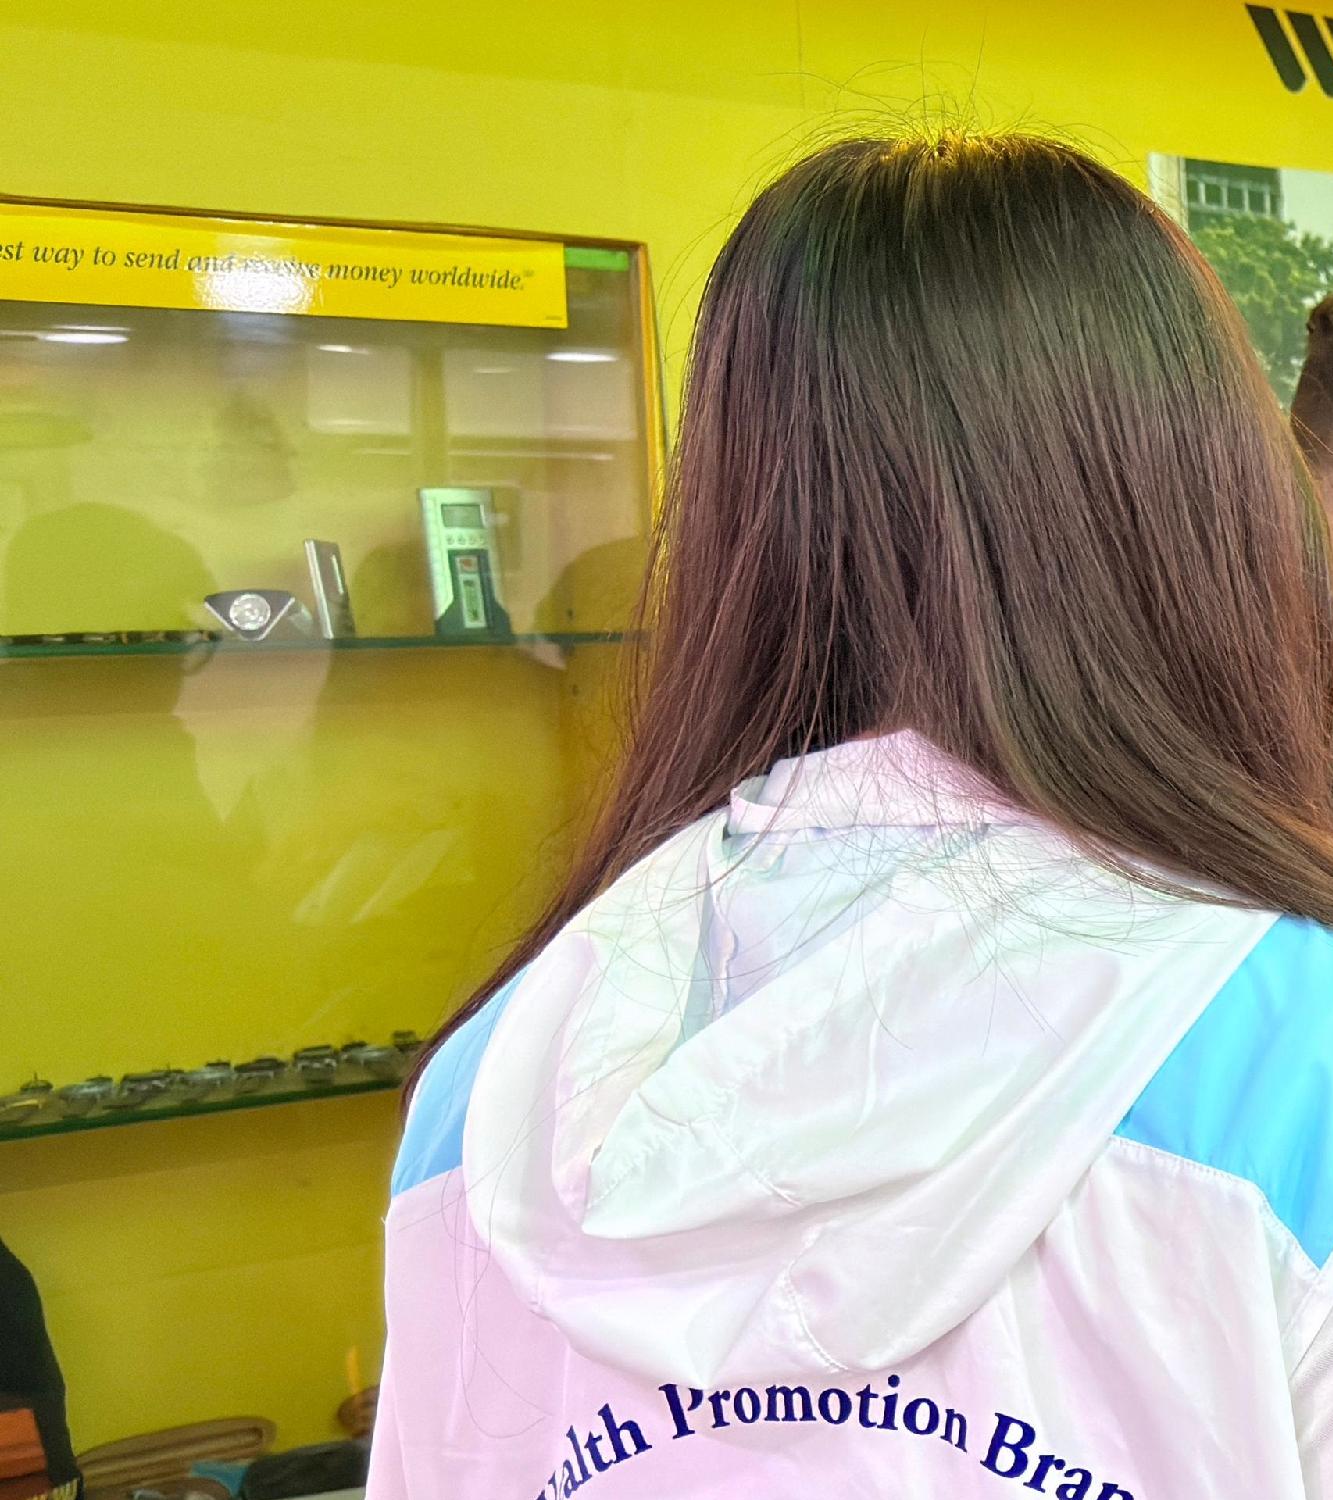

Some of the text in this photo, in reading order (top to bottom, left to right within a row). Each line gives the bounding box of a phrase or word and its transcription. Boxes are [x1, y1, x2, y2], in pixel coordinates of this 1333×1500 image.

[32, 245, 84, 271] way
[93, 246, 117, 267] to
[124, 249, 180, 272] send
[328, 262, 402, 289] money
[658, 1374, 969, 1453] Promotion
